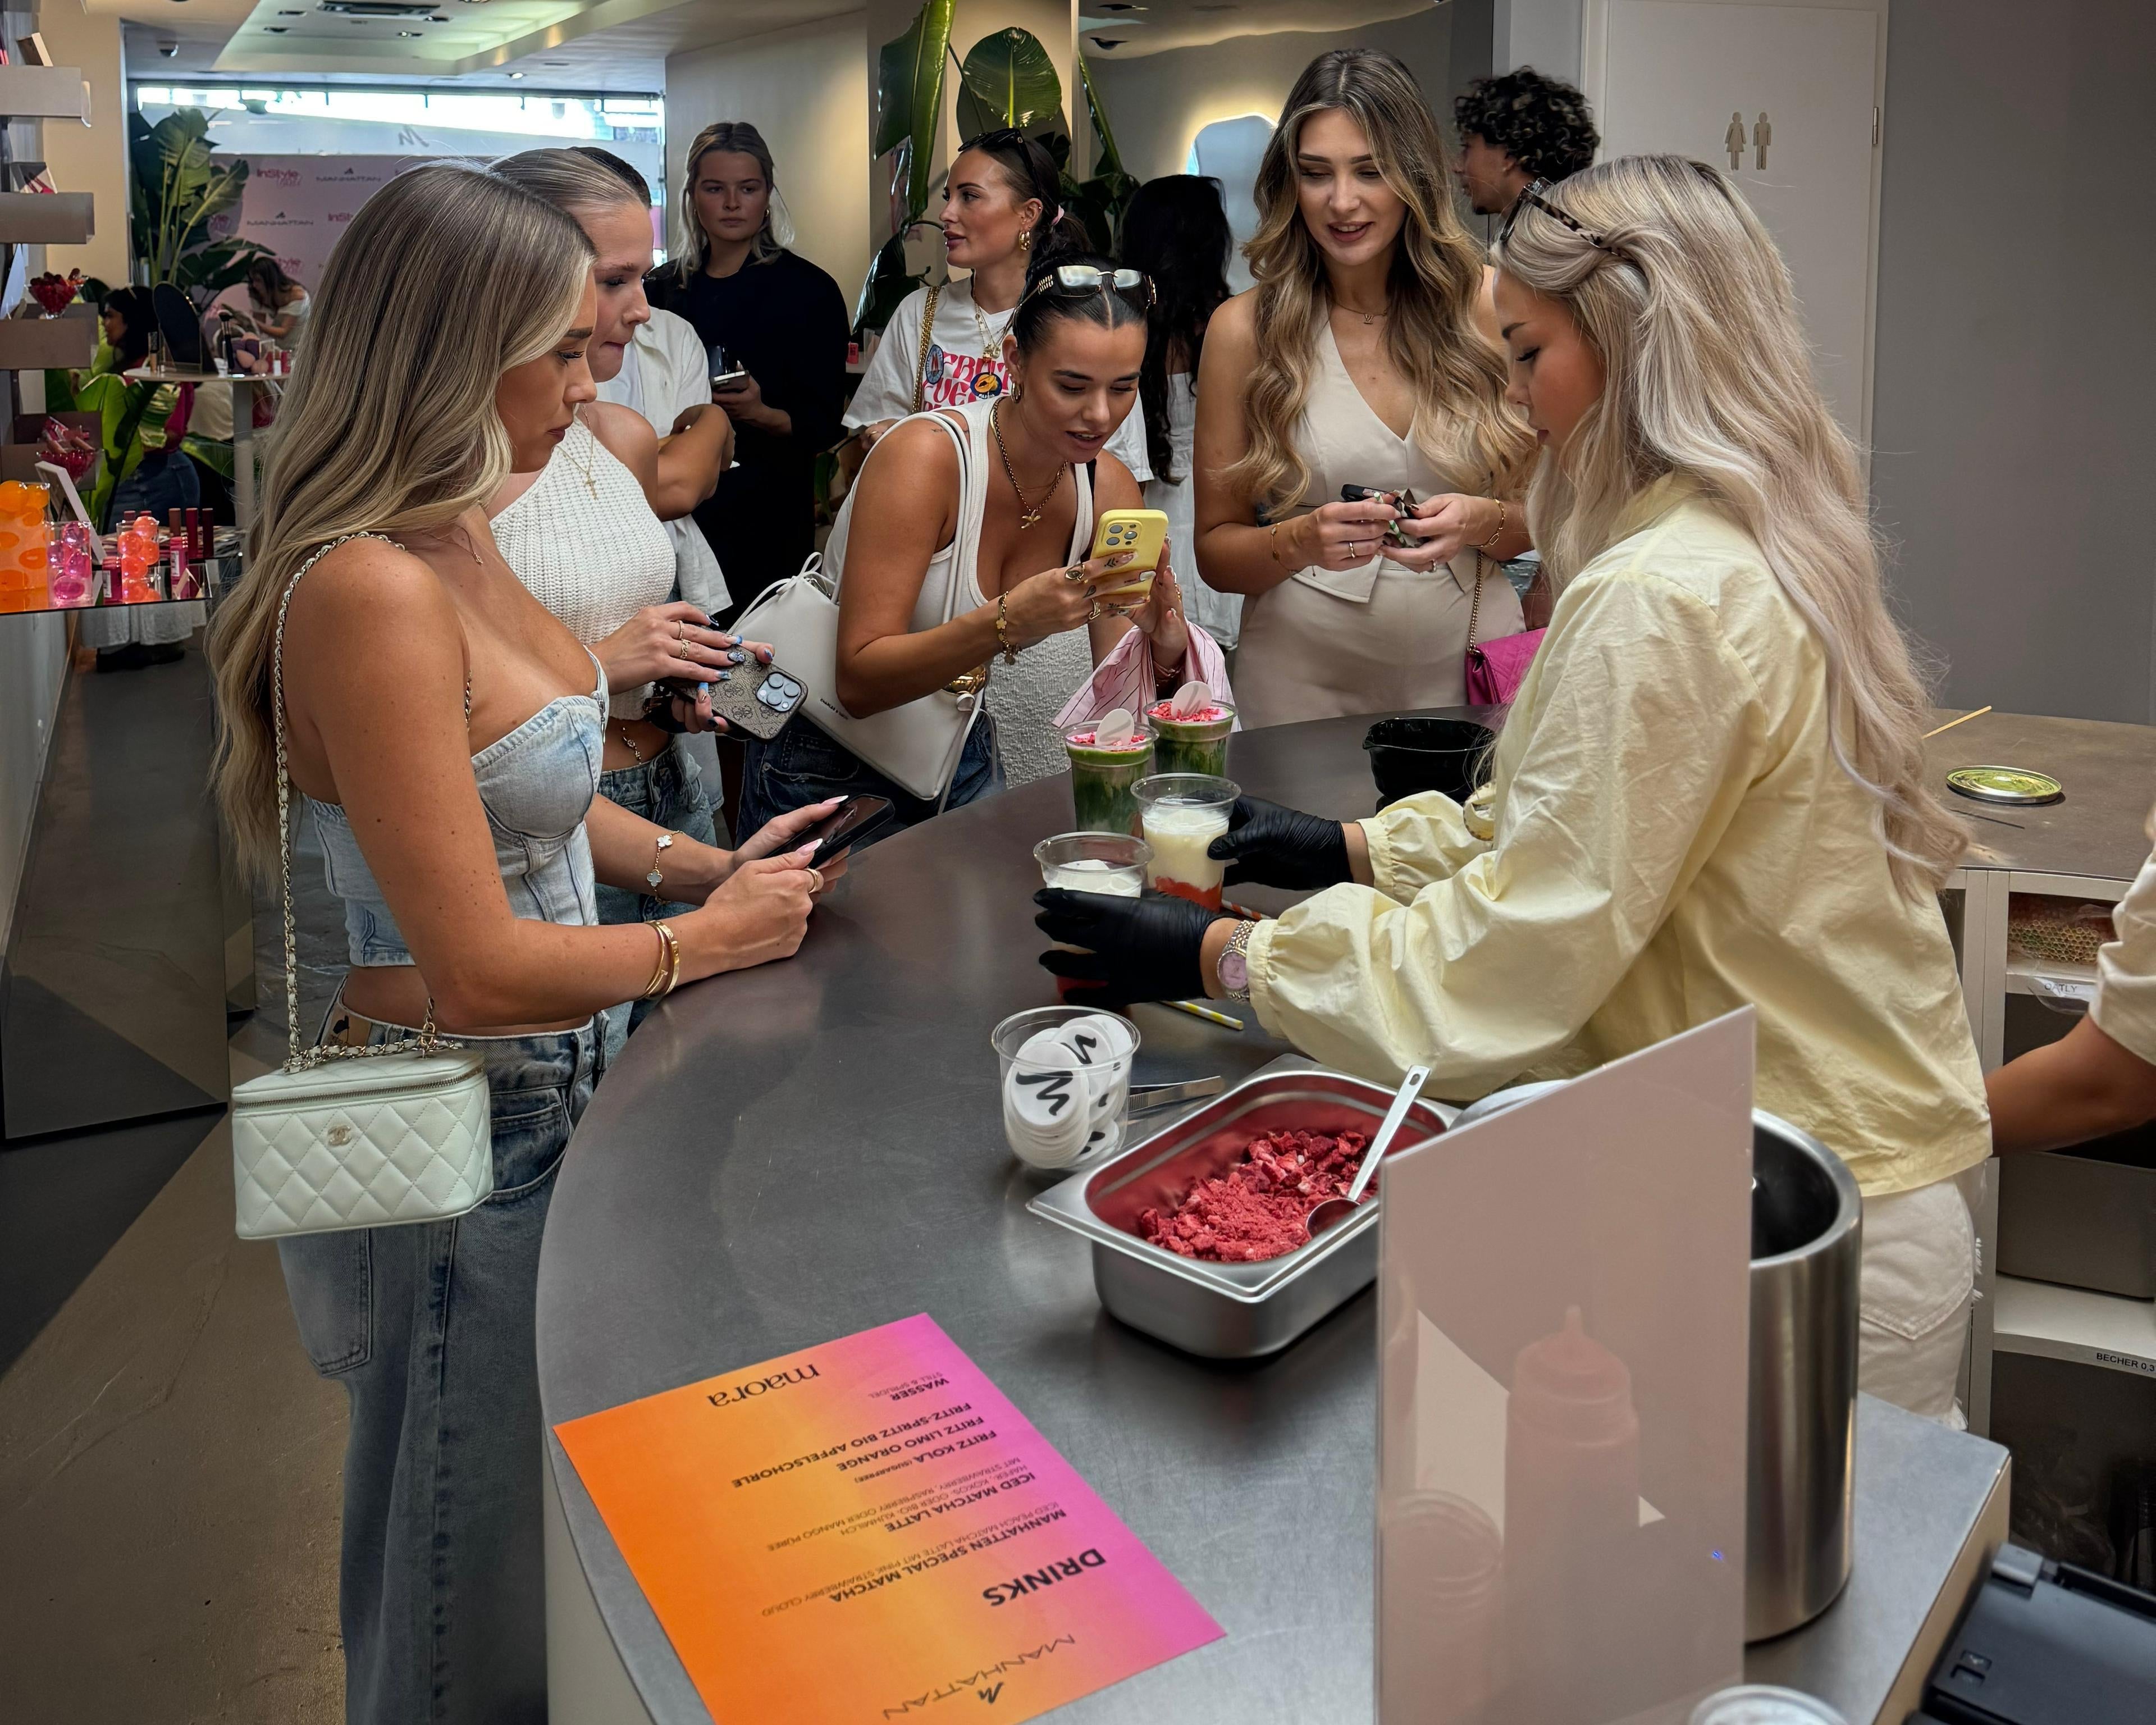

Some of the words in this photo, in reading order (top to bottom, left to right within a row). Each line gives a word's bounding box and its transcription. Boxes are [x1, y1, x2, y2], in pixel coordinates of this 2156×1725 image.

[2044, 983, 2077, 993] OATLY
[2096, 1352, 2138, 1368] BECHER
[706, 1363, 820, 1407] maora
[919, 1371, 943, 1382] STILL
[867, 1381, 910, 1398] SPRUDEL
[889, 1377, 949, 1400] WASSER
[879, 1402, 972, 1438] FRITZ-SPRITZ
[943, 1416, 984, 1435] FRITZ
[850, 1433, 878, 1447] BIO
[904, 1430, 943, 1448] LIMO
[956, 1430, 997, 1449] FRITZ
[835, 1444, 902, 1471] ORANGE
[912, 1444, 955, 1463] KOLA
[1003, 1457, 1021, 1468] MIT
[731, 1443, 846, 1487] APFELSCHORLE
[854, 1459, 912, 1483] (SUGARFREE)
[934, 1463, 1002, 1491] STRAWBERRY,
[999, 1472, 1035, 1490] ICED
[879, 1487, 934, 1512] RASPBERRY
[931, 1485, 998, 1514] MATCHA
[1034, 1501, 1059, 1514] ICED
[846, 1508, 876, 1523] ODER
[884, 1509, 931, 1532] LATTE
[998, 1510, 1034, 1528] PEACH
[802, 1519, 846, 1539] MANGO
[953, 1523, 999, 1544] MATCHA
[969, 1509, 1066, 1551] MANHATTEN
[766, 1535, 801, 1551] PÜREE
[921, 1540, 954, 1557] LATTE
[875, 1559, 901, 1574] PINK
[901, 1545, 968, 1575] SPECIAL
[903, 1553, 921, 1564] MIT
[805, 1570, 875, 1601] STRAWBERRY
[829, 1570, 902, 1602] MATCHA
[982, 1548, 1106, 1607] DRINKS
[761, 1596, 802, 1617] CLOUD
[882, 1633, 1075, 1719] MANHATTAN
